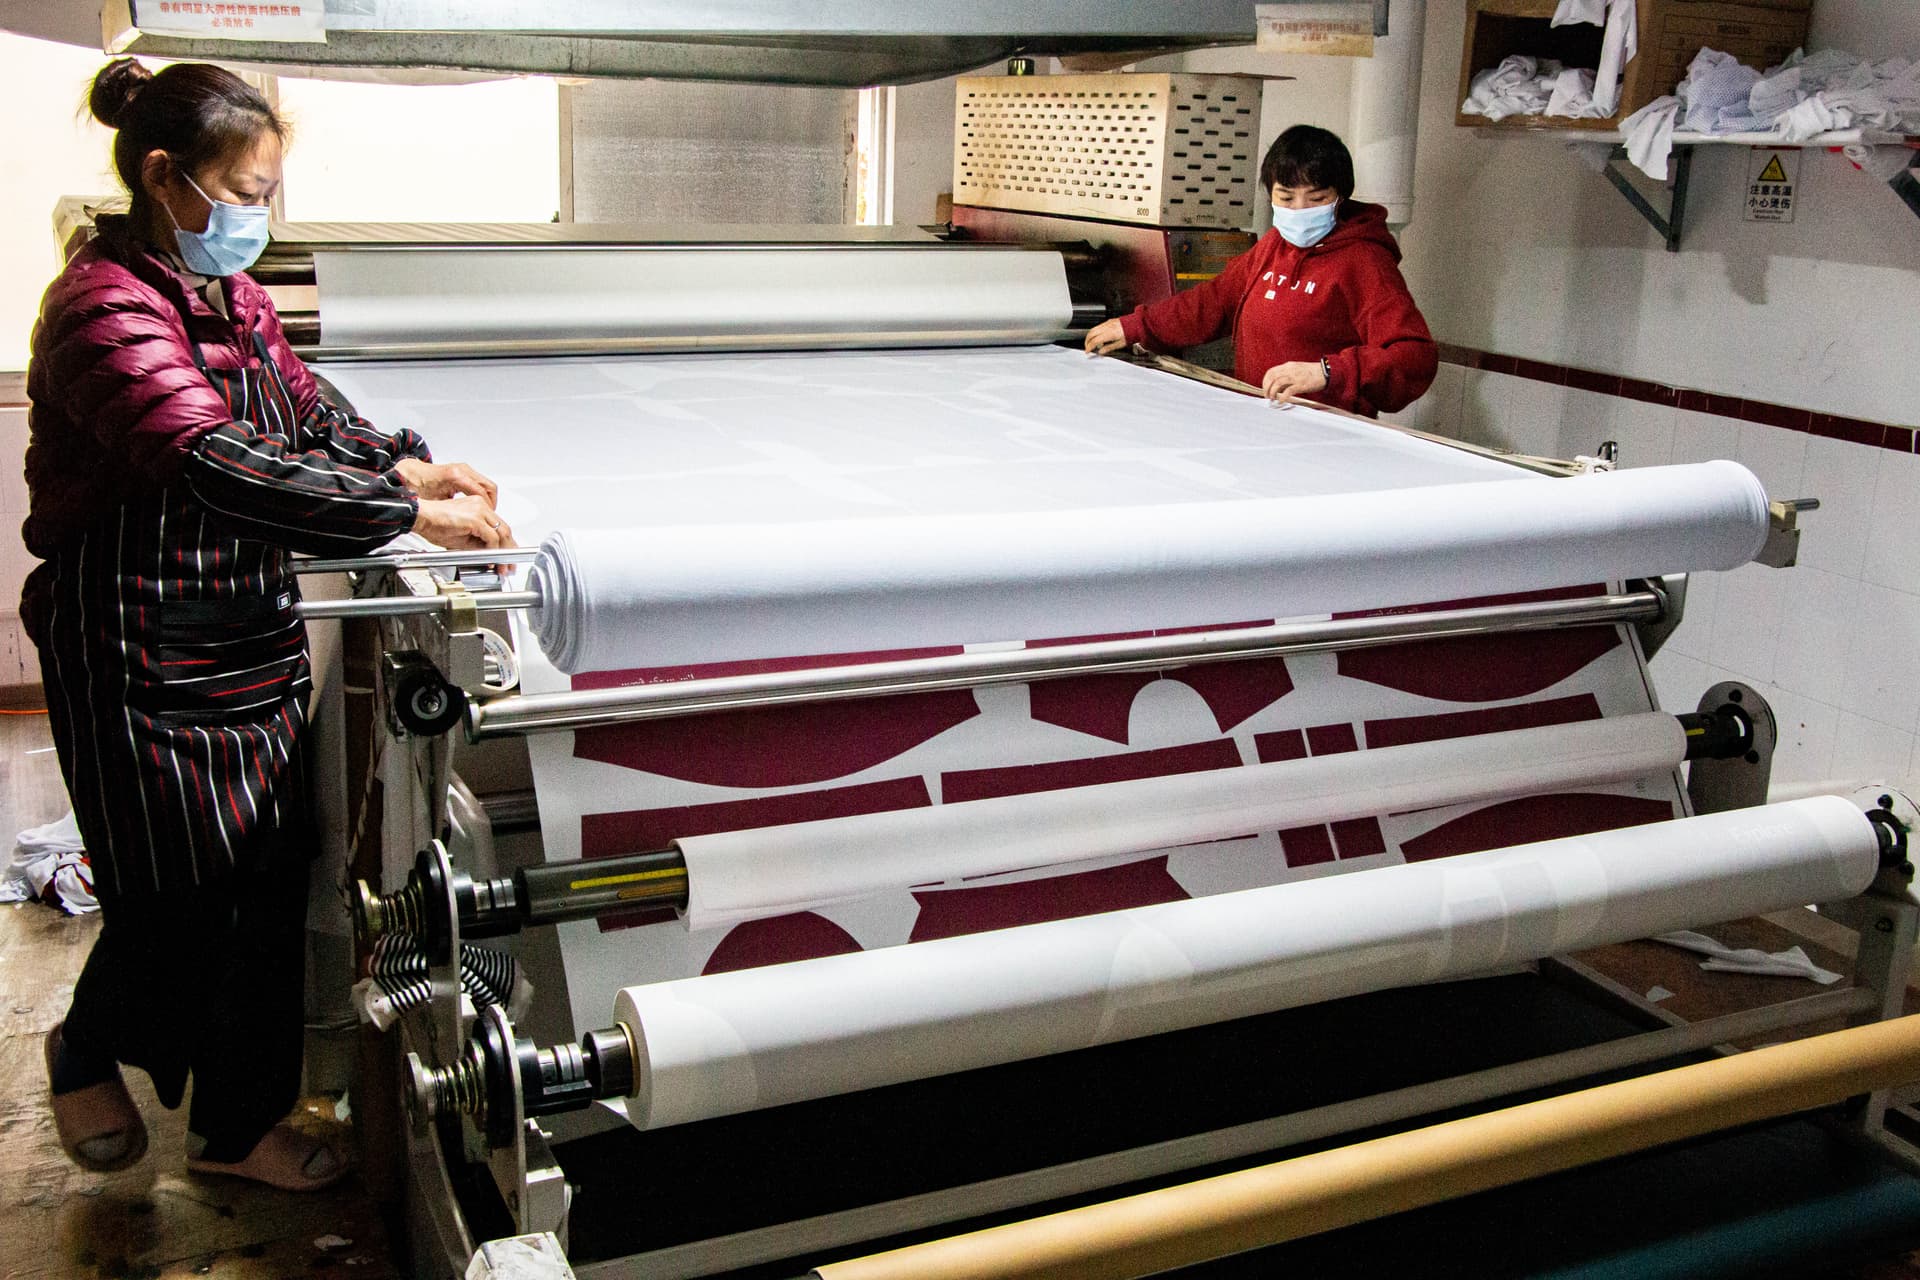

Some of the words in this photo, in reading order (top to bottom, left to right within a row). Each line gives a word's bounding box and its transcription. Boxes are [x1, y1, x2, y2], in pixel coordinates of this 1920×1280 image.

[1750, 185, 1792, 196] 注意高温
[1748, 198, 1791, 209] 小心烫伤
